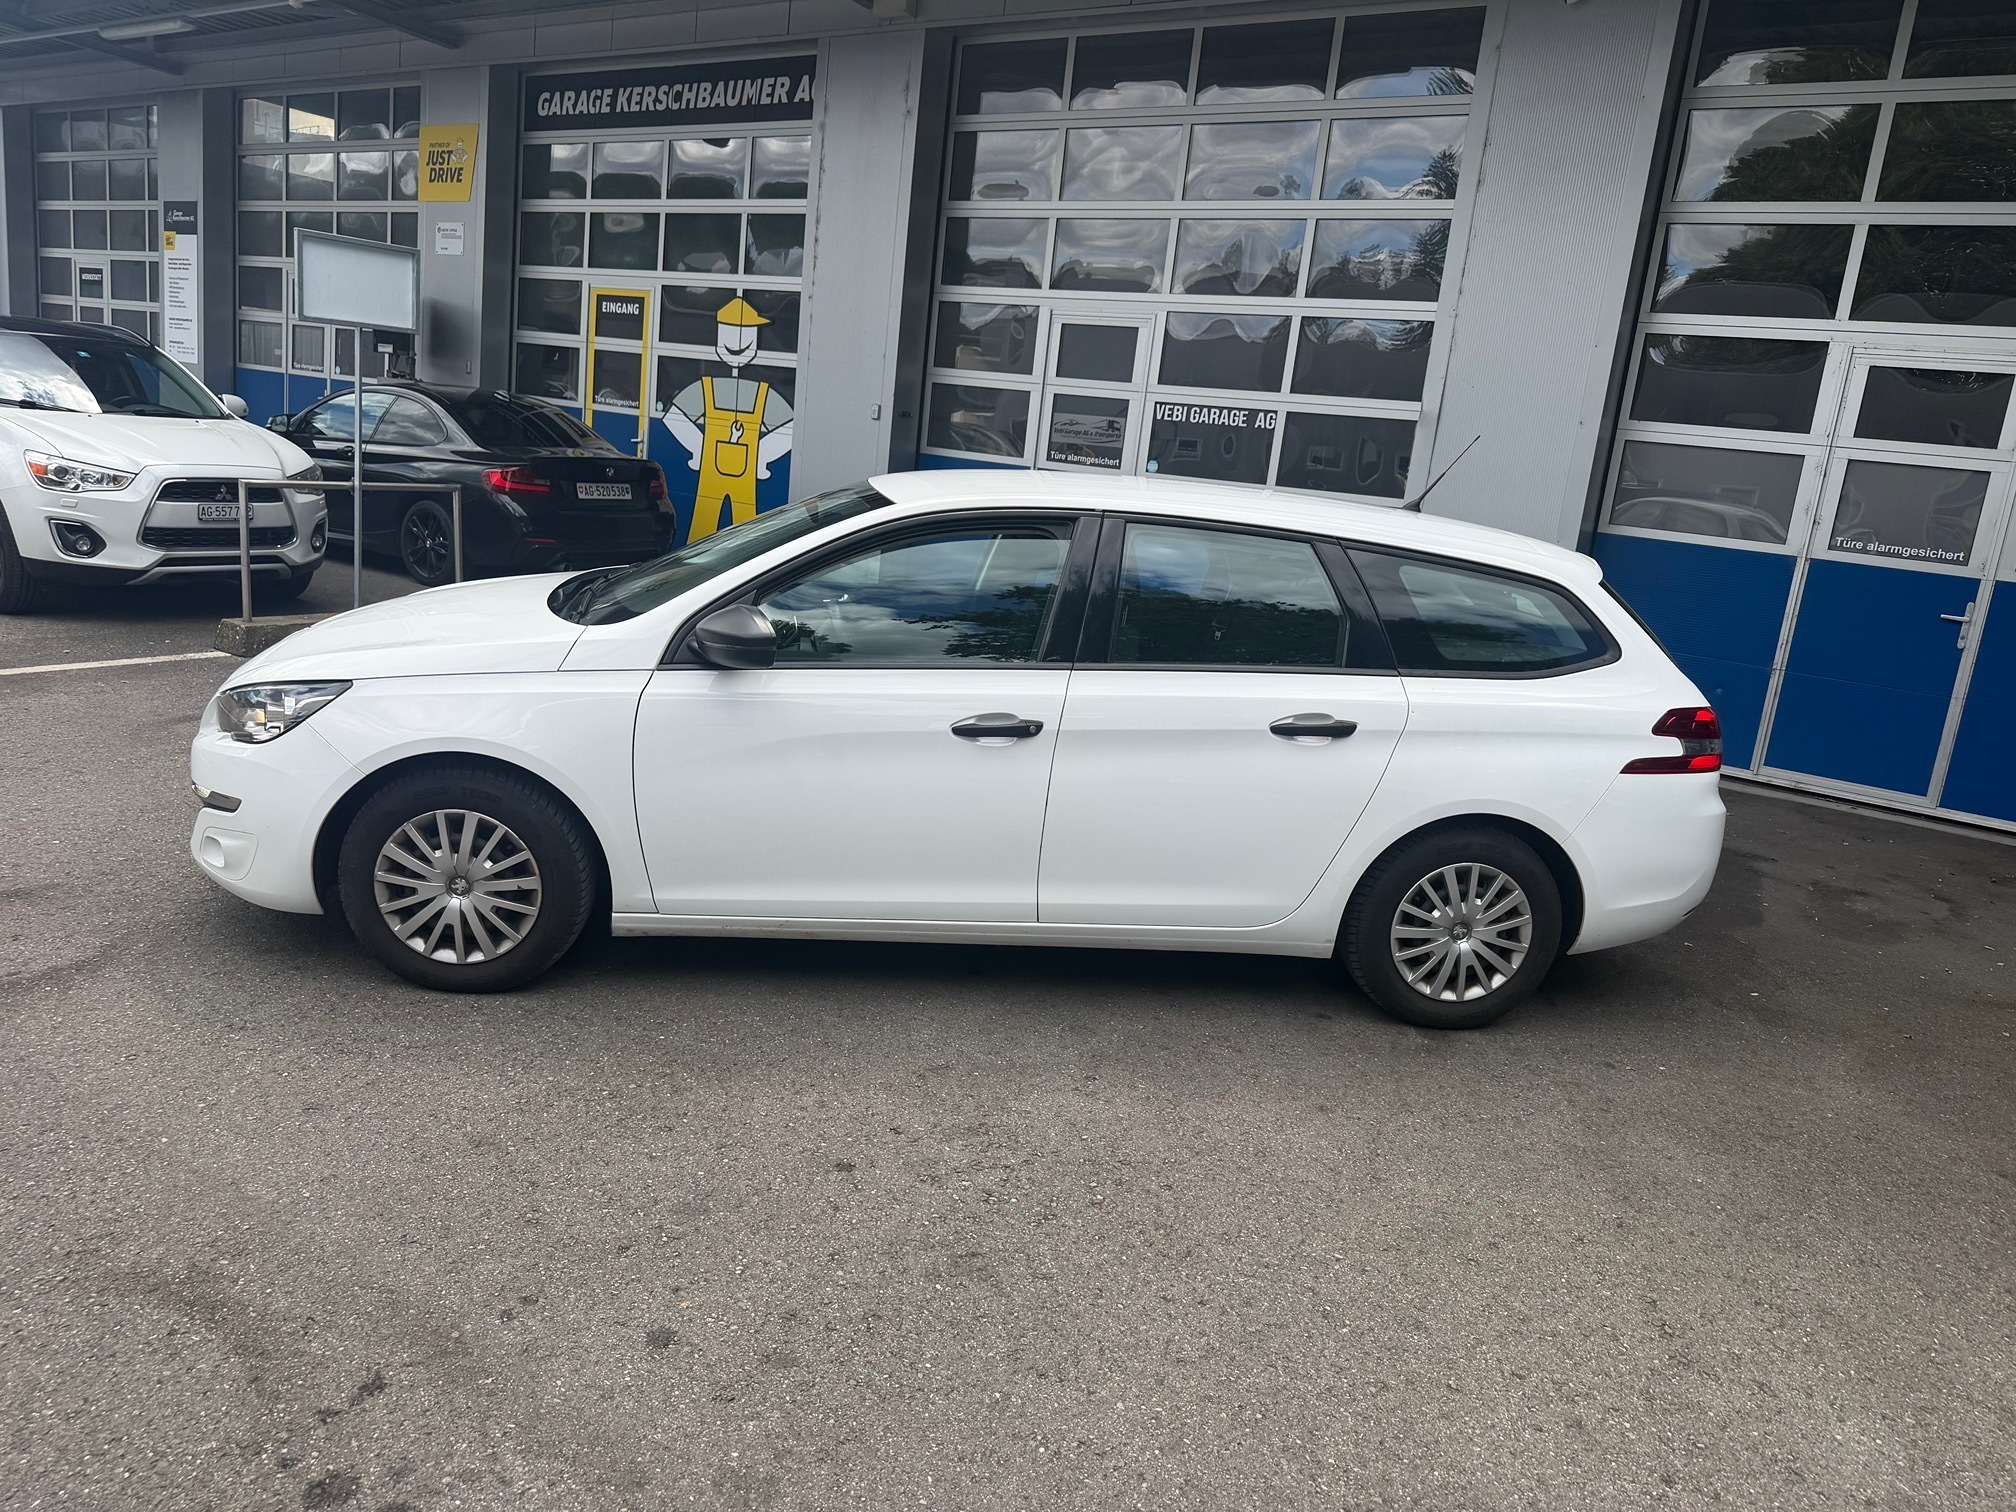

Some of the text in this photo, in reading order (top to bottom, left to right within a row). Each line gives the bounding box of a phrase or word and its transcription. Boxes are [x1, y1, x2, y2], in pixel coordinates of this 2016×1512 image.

[537, 75, 816, 116] GARAGE KERSCHBAUMER A
[426, 150, 454, 166] JUST
[428, 167, 464, 183] DRIVE
[602, 301, 640, 315] EINGANG
[1156, 403, 1277, 430] VEBI GARAGE AG
[1050, 451, 1120, 467] Türe alarmgesichert
[1835, 537, 1965, 561] Türe alarmgesichert
